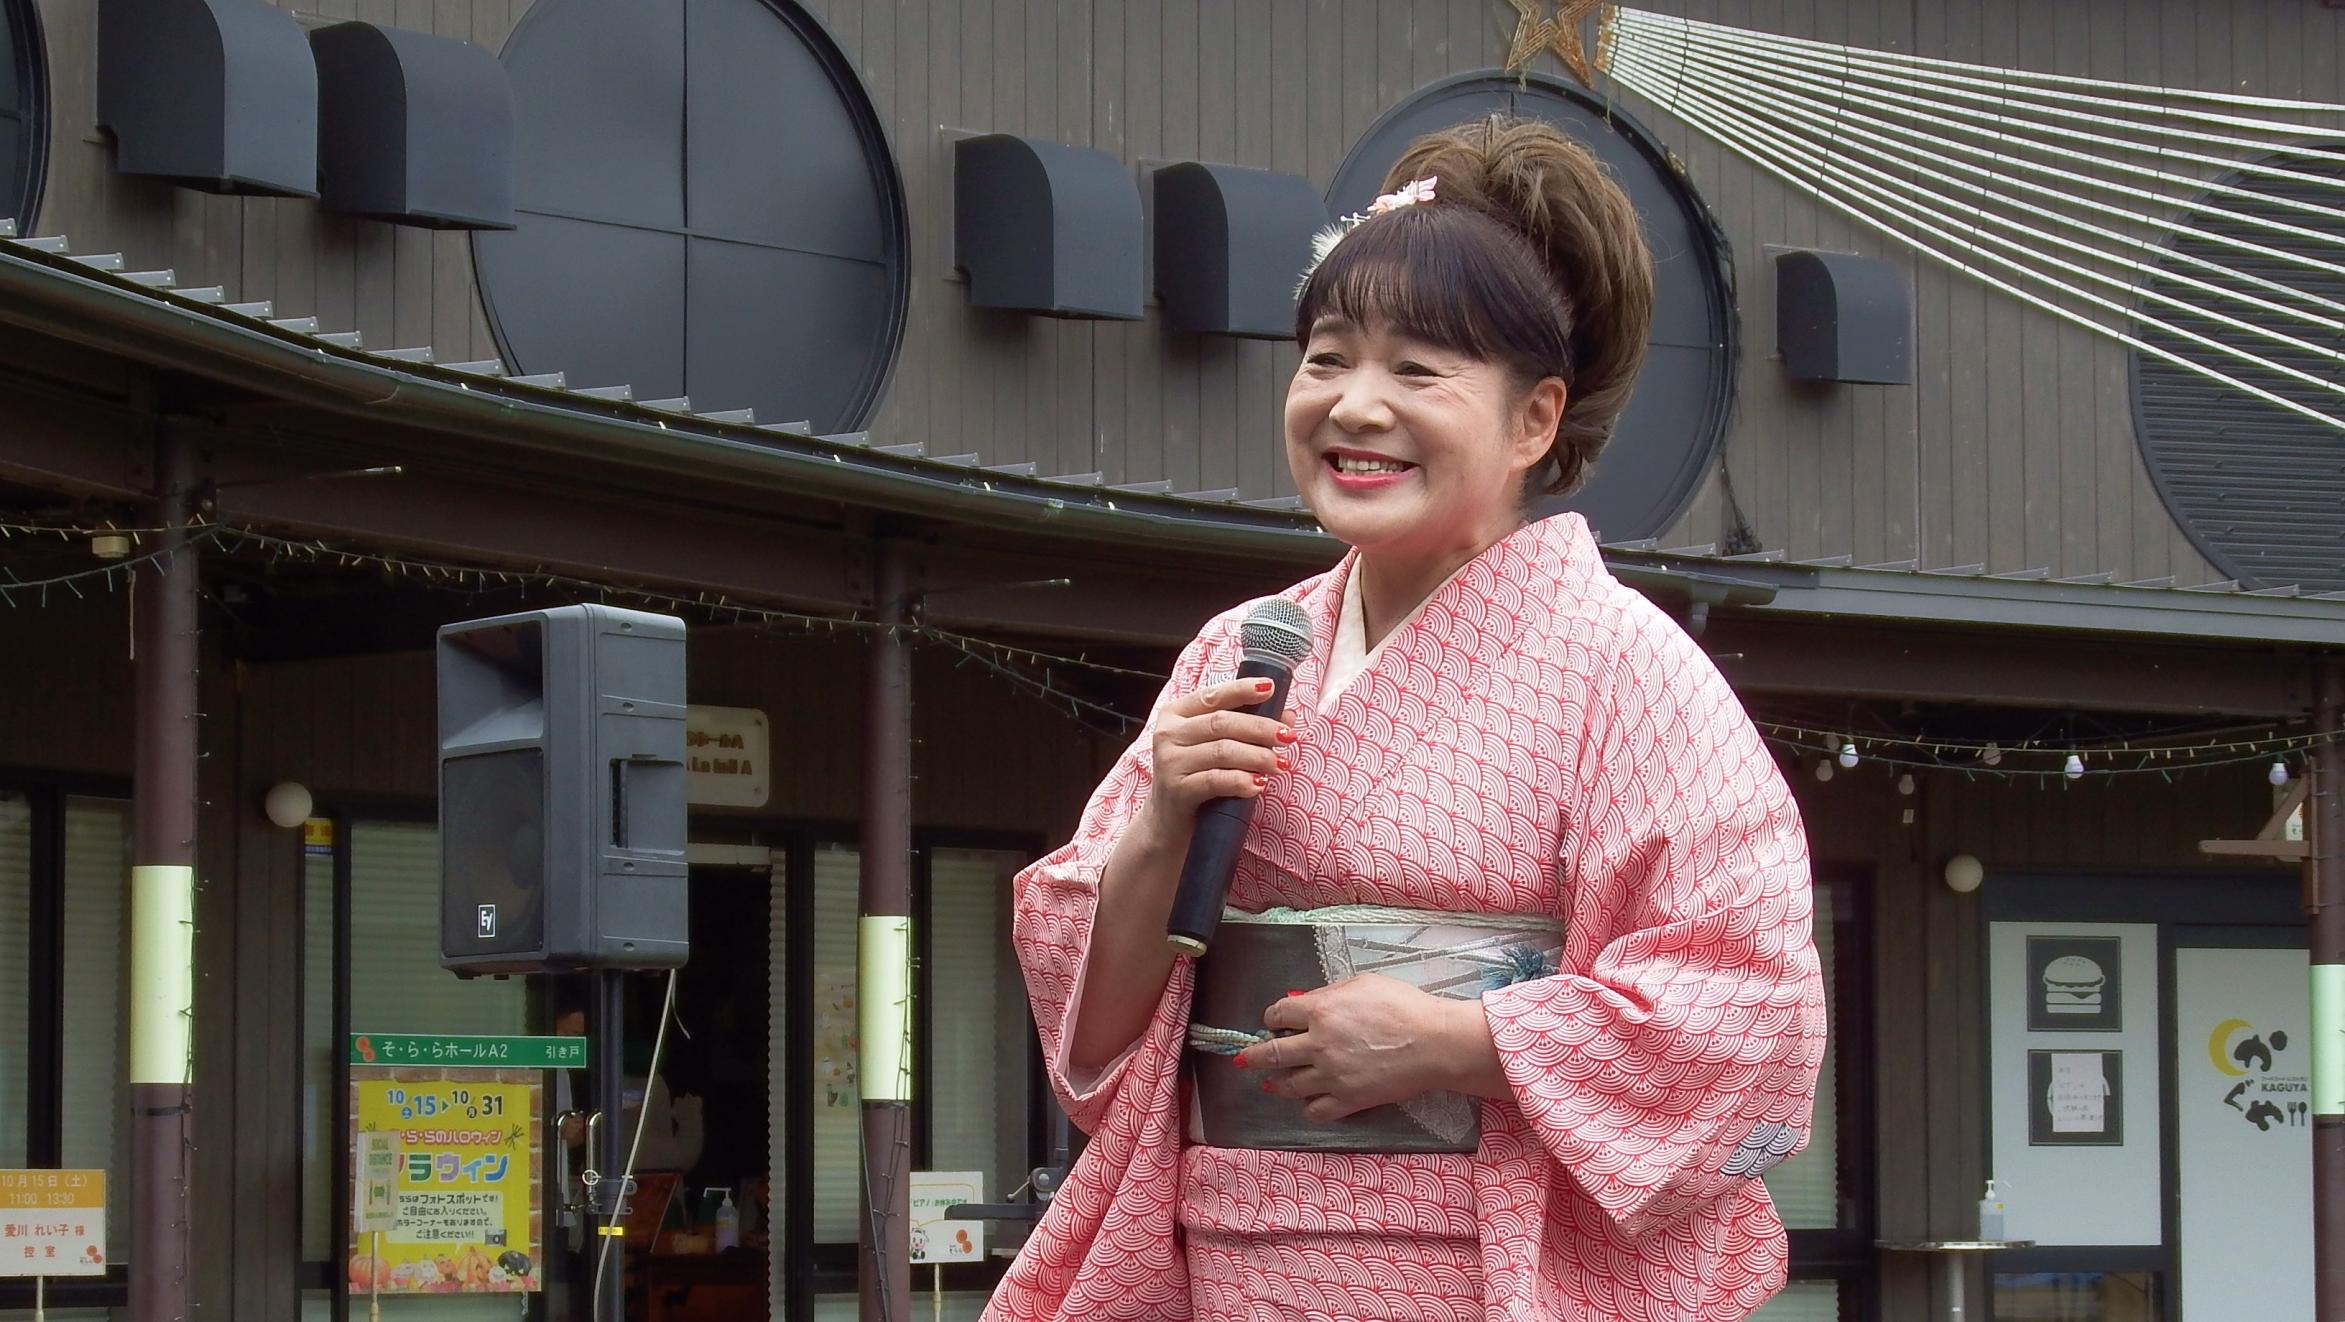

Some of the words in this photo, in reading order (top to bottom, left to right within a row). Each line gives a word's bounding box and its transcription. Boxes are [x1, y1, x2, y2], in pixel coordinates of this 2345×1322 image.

[545, 1045, 580, 1059] 引き戸
[2261, 1082, 2308, 1093] KAGUYA
[399, 1152, 509, 1183] ラウィン
